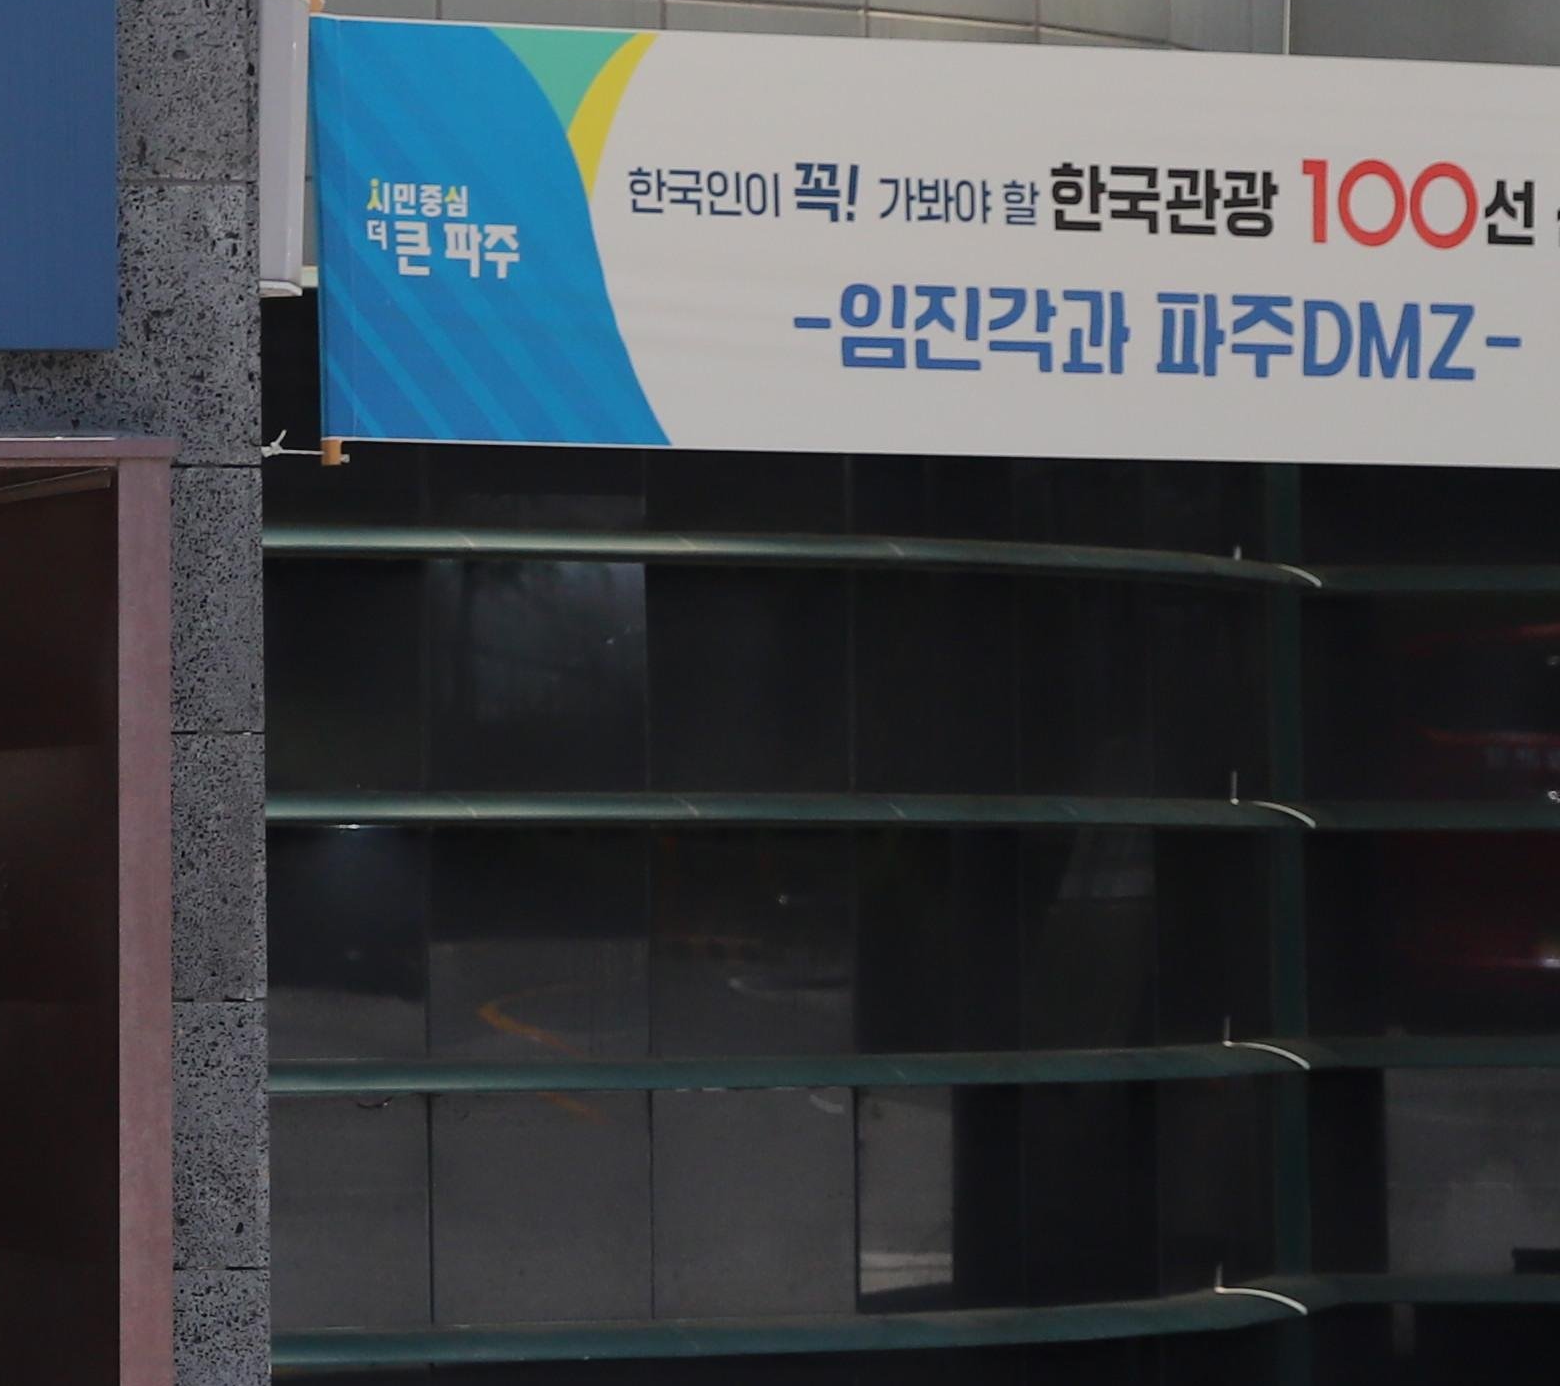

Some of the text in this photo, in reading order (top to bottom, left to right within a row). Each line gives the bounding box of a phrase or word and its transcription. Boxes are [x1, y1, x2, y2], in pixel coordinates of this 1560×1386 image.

[368, 179, 467, 217] 시민중심
[629, 168, 779, 217] 한국인이
[795, 163, 858, 222] 꼭!
[880, 178, 991, 223] 가봐야
[1003, 181, 1039, 225] 할
[1051, 163, 1278, 237] 한국관광
[367, 221, 520, 278] 더 큰 파주
